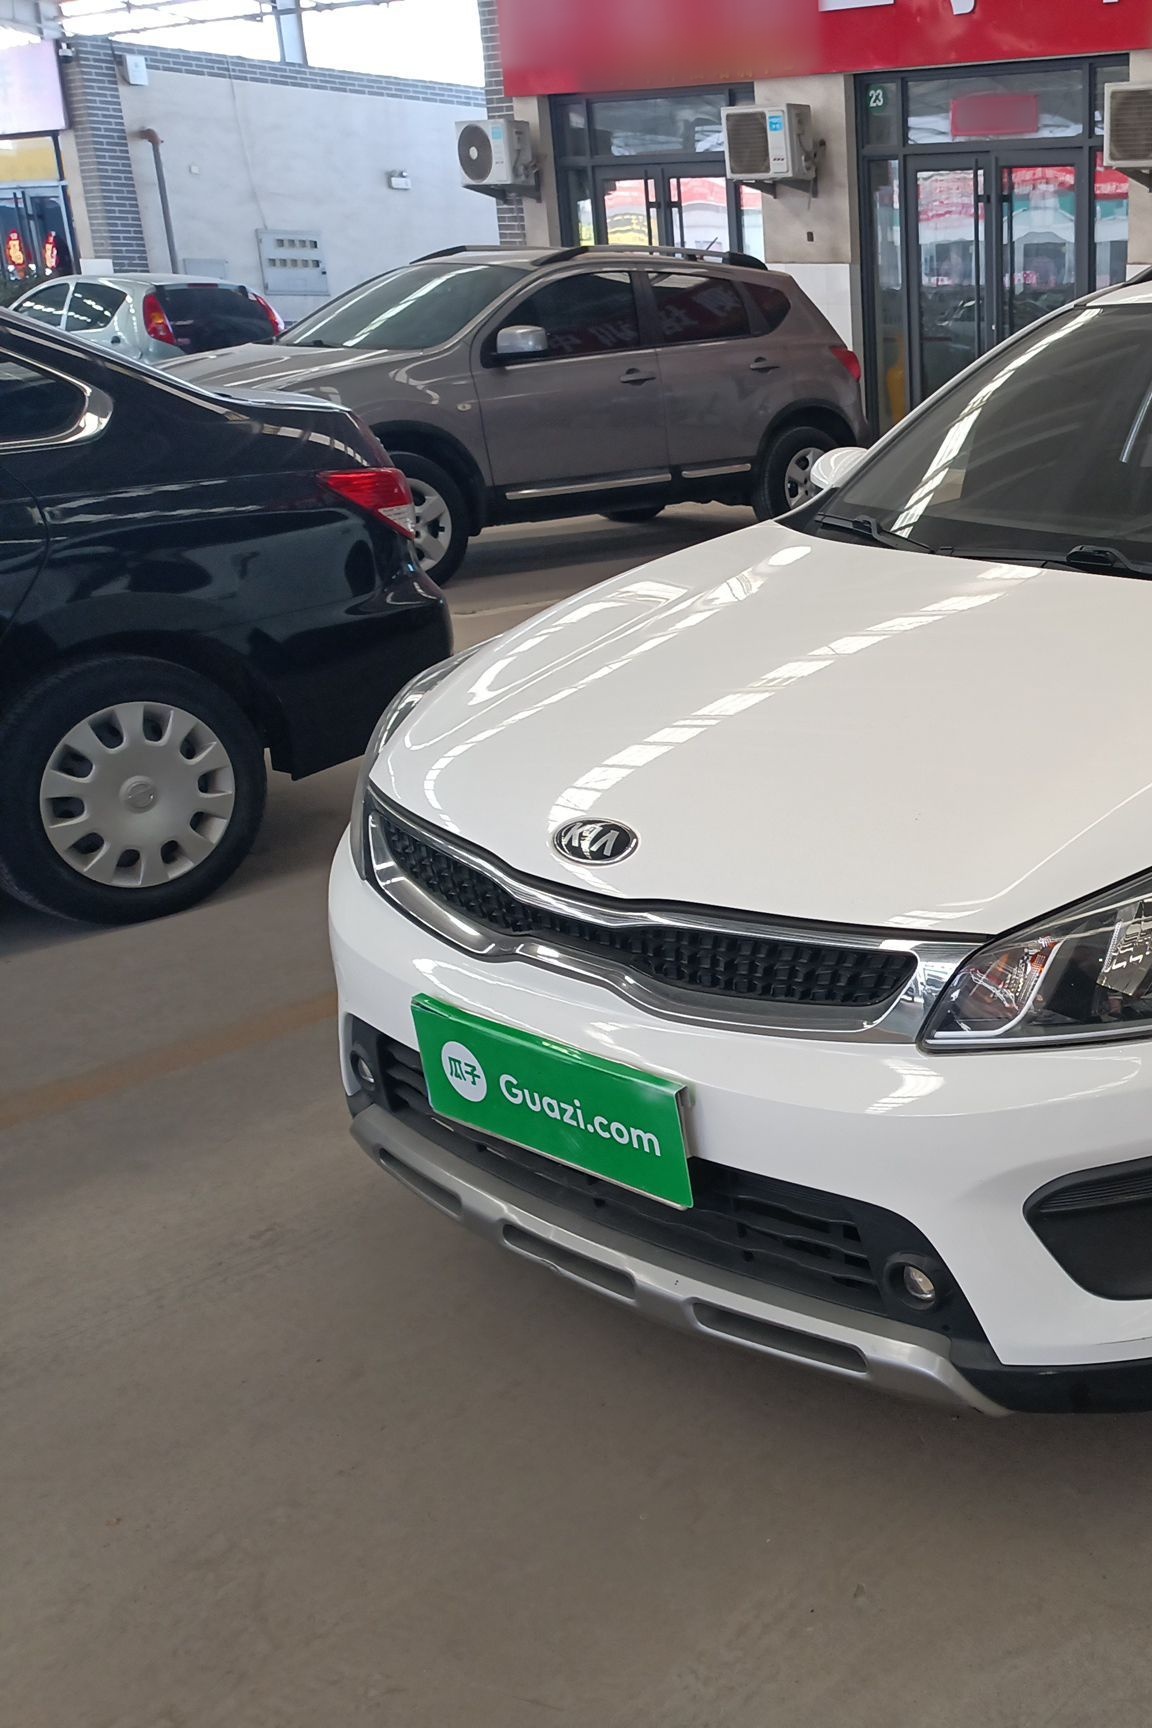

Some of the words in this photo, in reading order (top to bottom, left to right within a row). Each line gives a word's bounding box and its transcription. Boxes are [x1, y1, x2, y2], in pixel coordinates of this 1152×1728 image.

[869, 89, 884, 107] 23
[447, 1055, 481, 1087] 瓜子
[499, 1073, 662, 1157] Guazi.com
